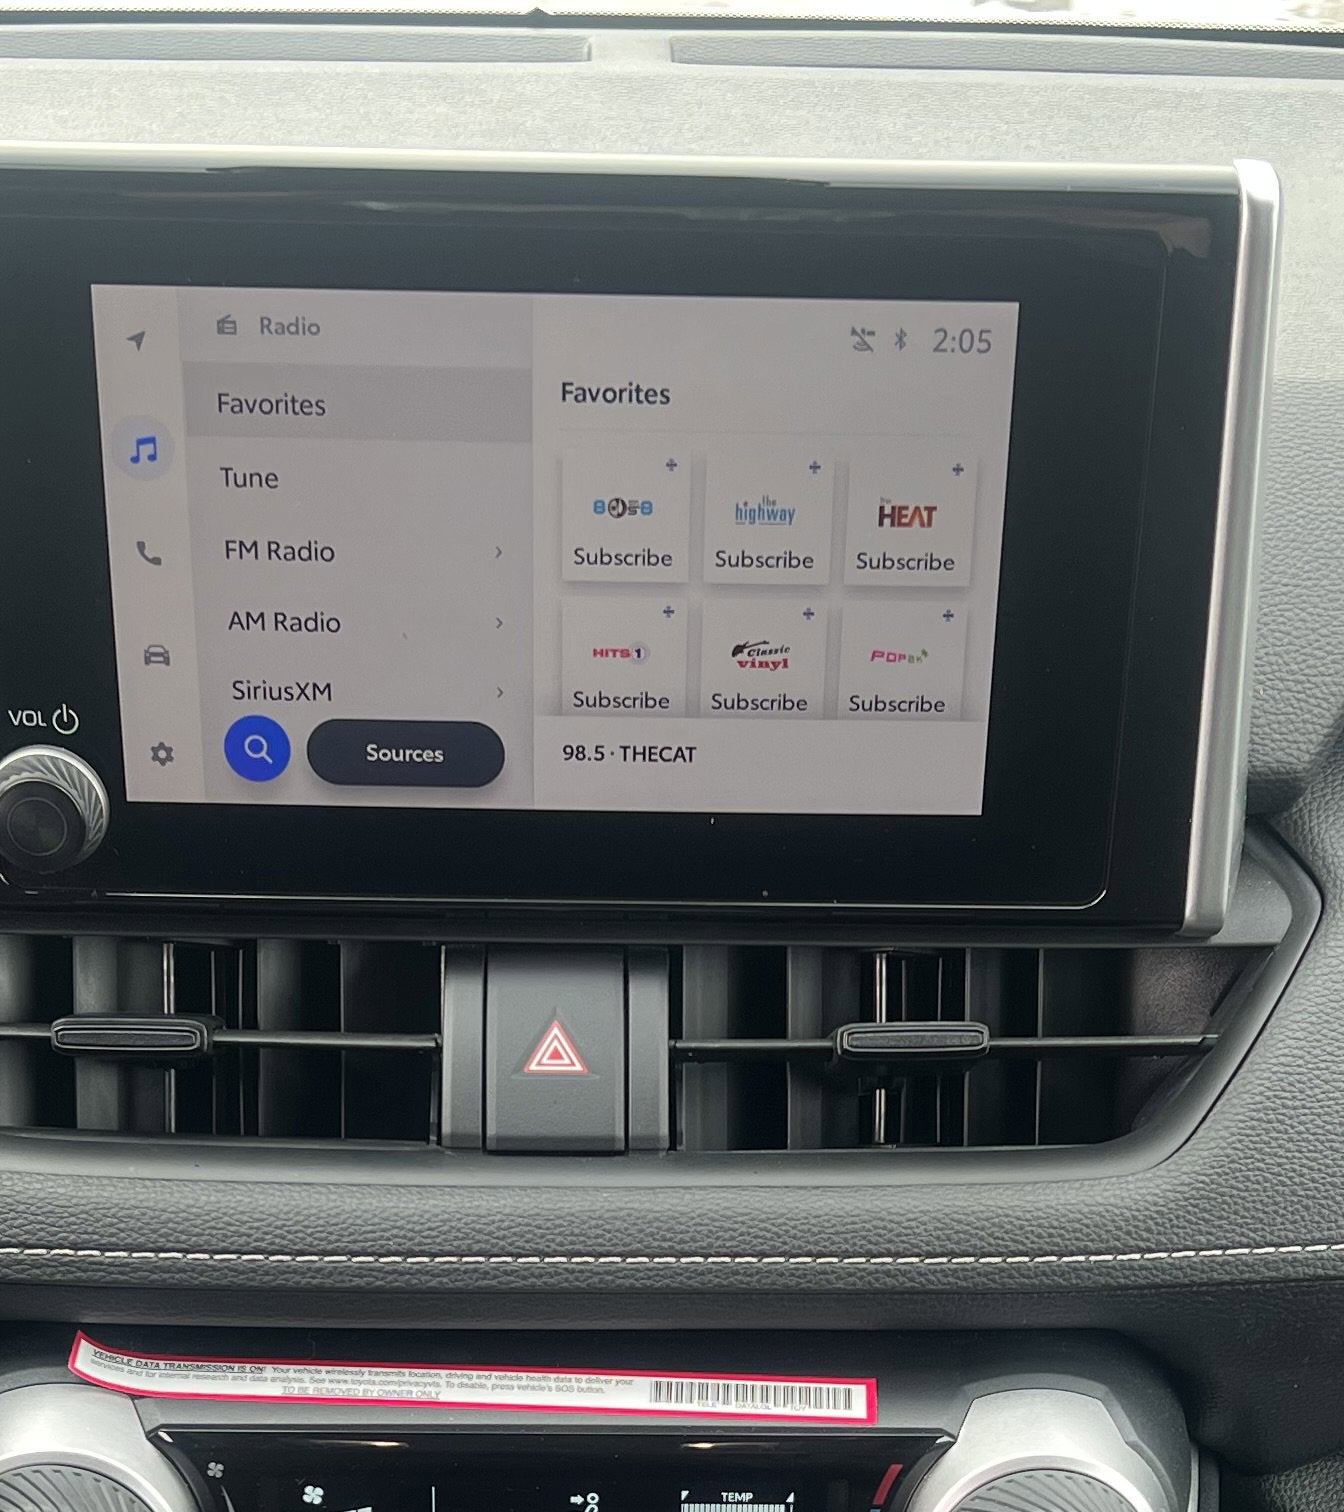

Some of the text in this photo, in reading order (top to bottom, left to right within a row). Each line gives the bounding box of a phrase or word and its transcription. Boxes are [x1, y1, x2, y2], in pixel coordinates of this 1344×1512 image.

[260, 316, 320, 336] Radio
[933, 328, 991, 354] 2:05
[562, 382, 670, 405] Favorites
[218, 393, 325, 416] Favorites
[220, 467, 278, 489] Tune
[735, 502, 796, 526] highway
[877, 505, 938, 529] HEAT
[225, 540, 334, 562] FM Radio
[574, 547, 672, 566] Subscribe
[716, 550, 813, 568] Subscribe
[857, 552, 954, 570] Subscribe
[229, 611, 340, 633] AM Radio
[592, 648, 630, 659] HITS
[736, 657, 790, 671] vinyl
[233, 680, 331, 701] SiriusXM
[573, 691, 669, 709] Subscribe
[712, 693, 807, 711] Subscribe
[849, 695, 945, 712] Subscribe
[8, 710, 47, 726] VOL
[367, 744, 443, 762] Sources
[563, 745, 696, 763] 98.5 THECAT
[721, 1492, 753, 1502] TEMP
